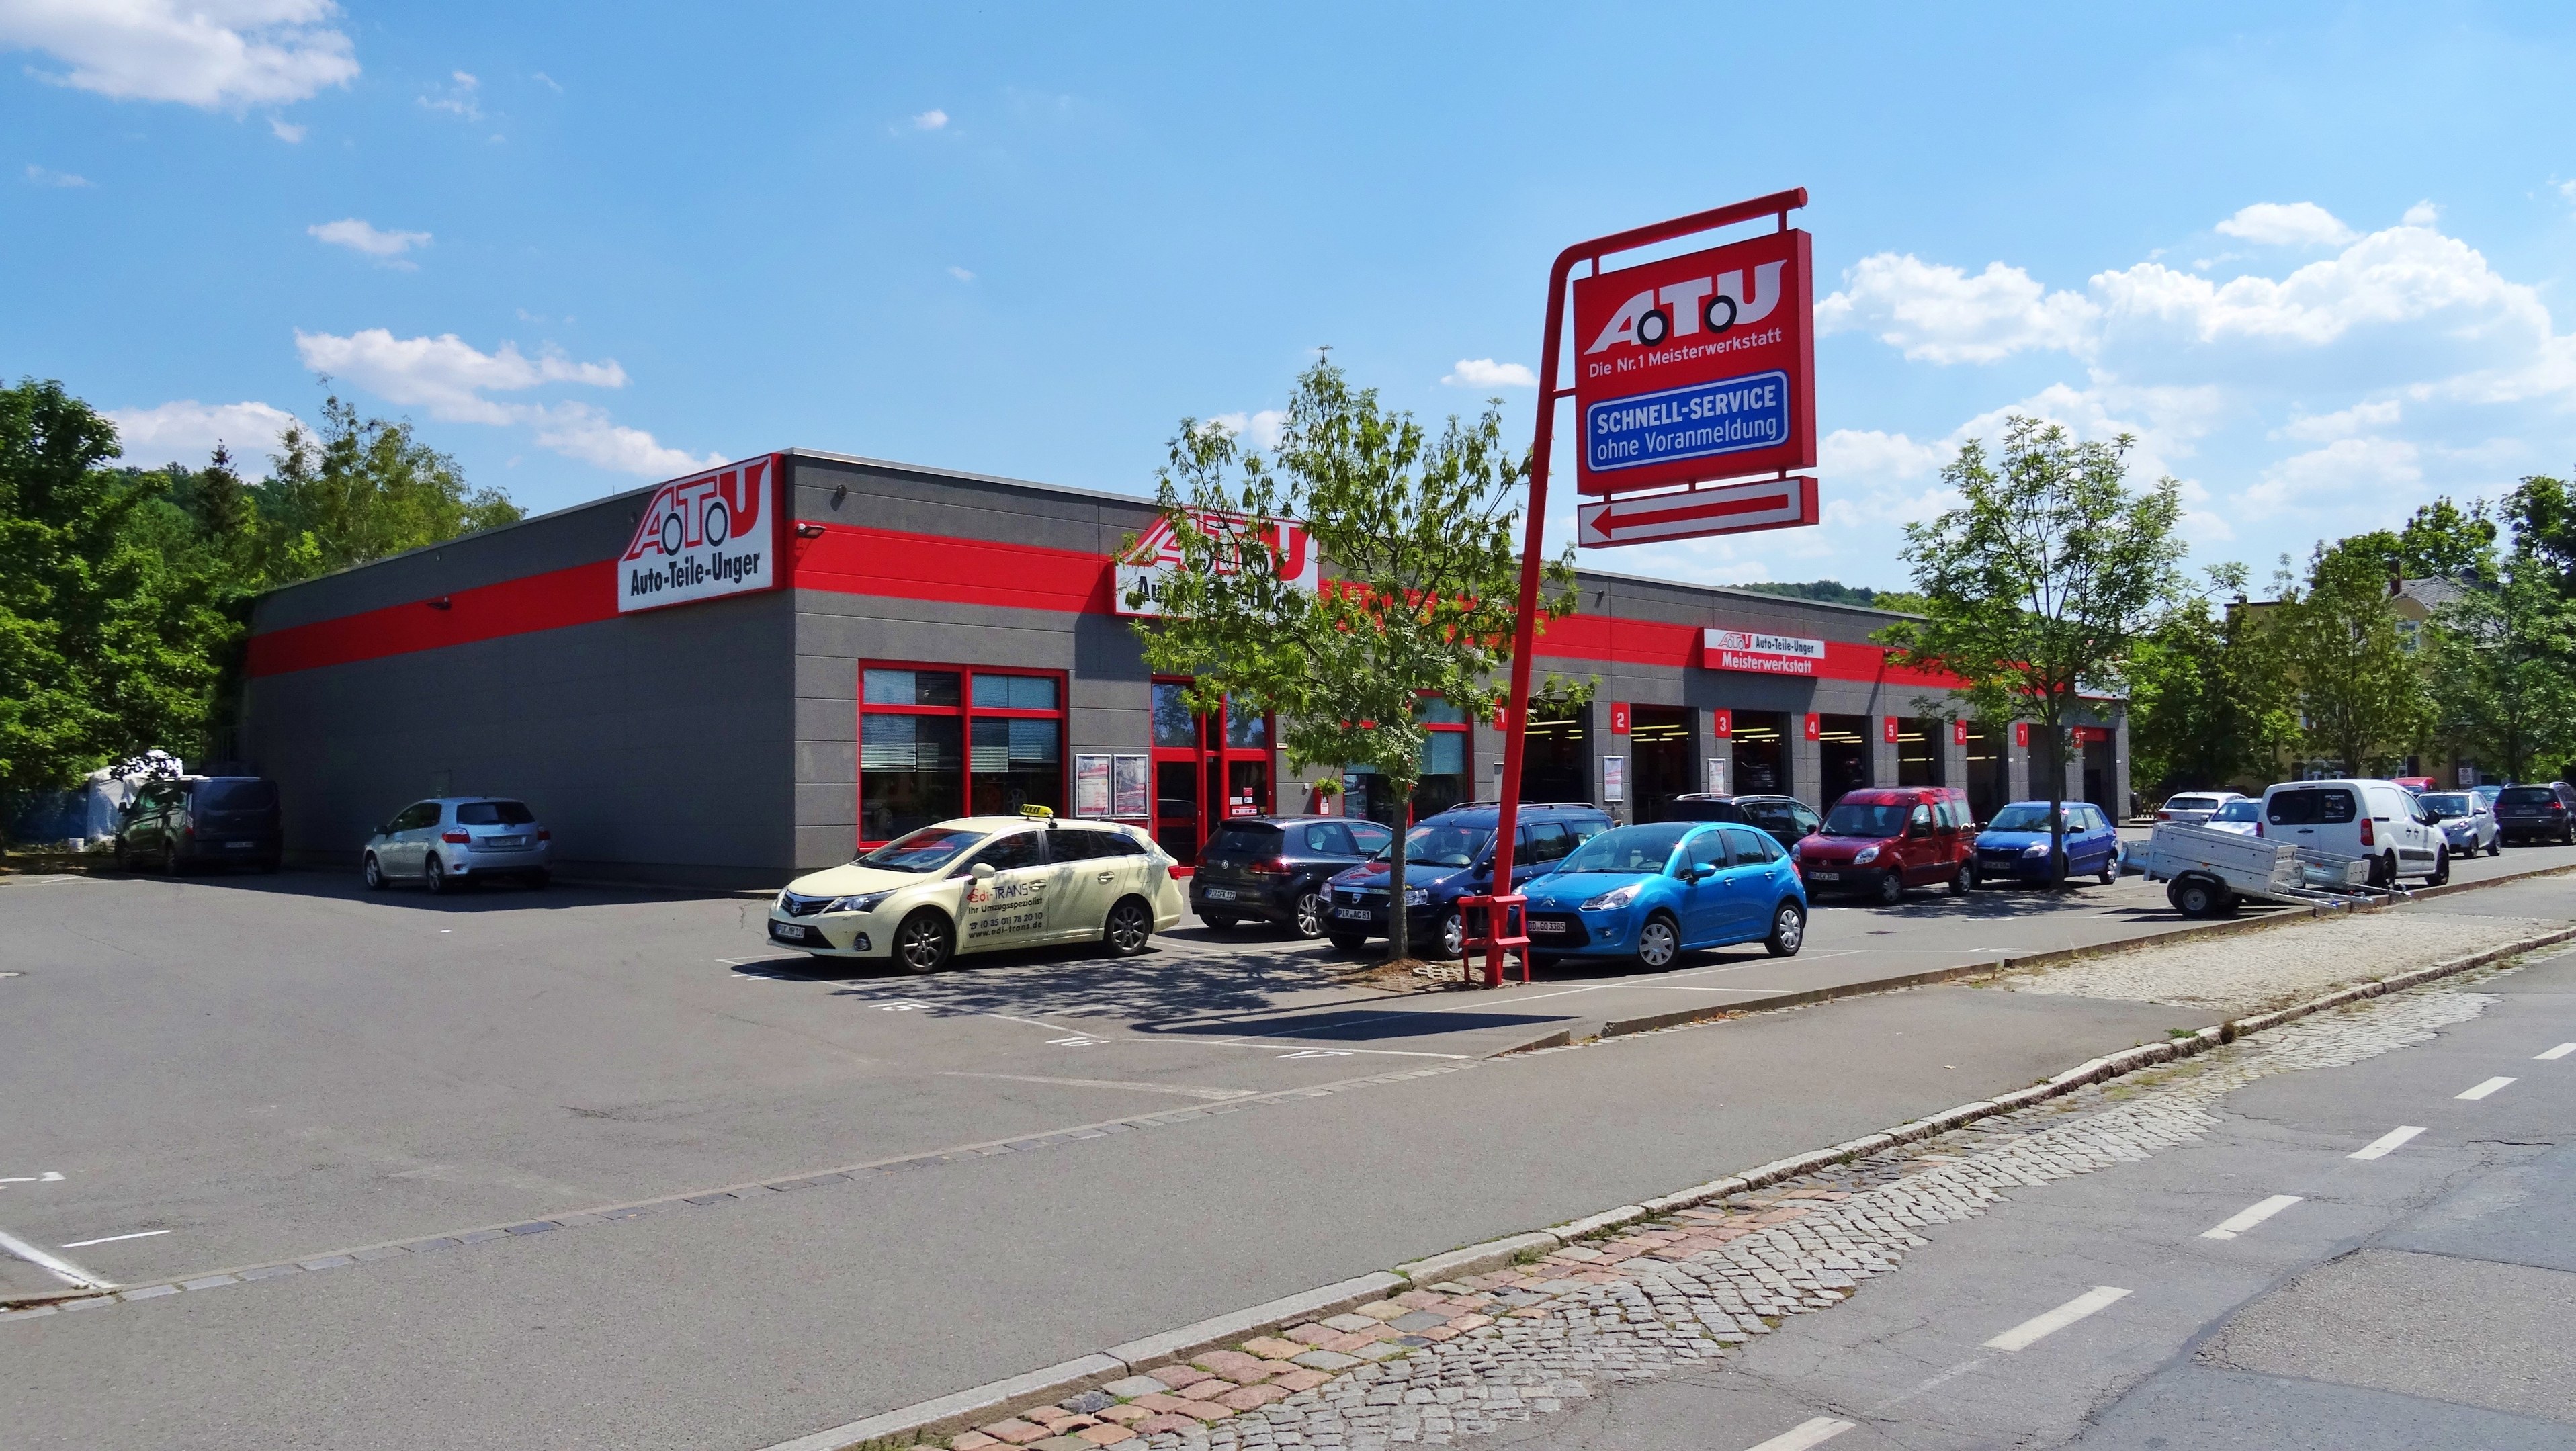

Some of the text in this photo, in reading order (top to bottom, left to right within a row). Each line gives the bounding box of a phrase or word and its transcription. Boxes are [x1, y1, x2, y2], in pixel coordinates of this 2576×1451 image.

[1589, 363, 1611, 378] Die
[1649, 327, 1782, 366] Meisterwerkstatt
[1597, 384, 1776, 435] SCHNELL-SERVICE
[1597, 416, 1776, 461] ohne Voranmeldung
[630, 552, 761, 596] Auto-Teile-Unger
[1756, 636, 1814, 655] Auto-Teile-Unger
[1721, 651, 1812, 673] Meisterwerkstatt
[1498, 707, 1505, 723] 1
[1617, 712, 1625, 728] 2
[1719, 717, 1727, 732] 3
[1809, 721, 1815, 734] 4
[1888, 724, 1894, 737] 5
[1958, 727, 1963, 740] 6
[2020, 730, 2025, 742] 7
[1023, 805, 1039, 814] TAXI
[966, 883, 1029, 903] Edi-TRANS
[968, 897, 1043, 914] Ihr Umzugsspezialist
[990, 919, 999, 927] 35
[1024, 914, 1033, 922] 20
[1338, 909, 1370, 920] PIR AC 81
[968, 921, 1043, 938] www.edi-trans.de
